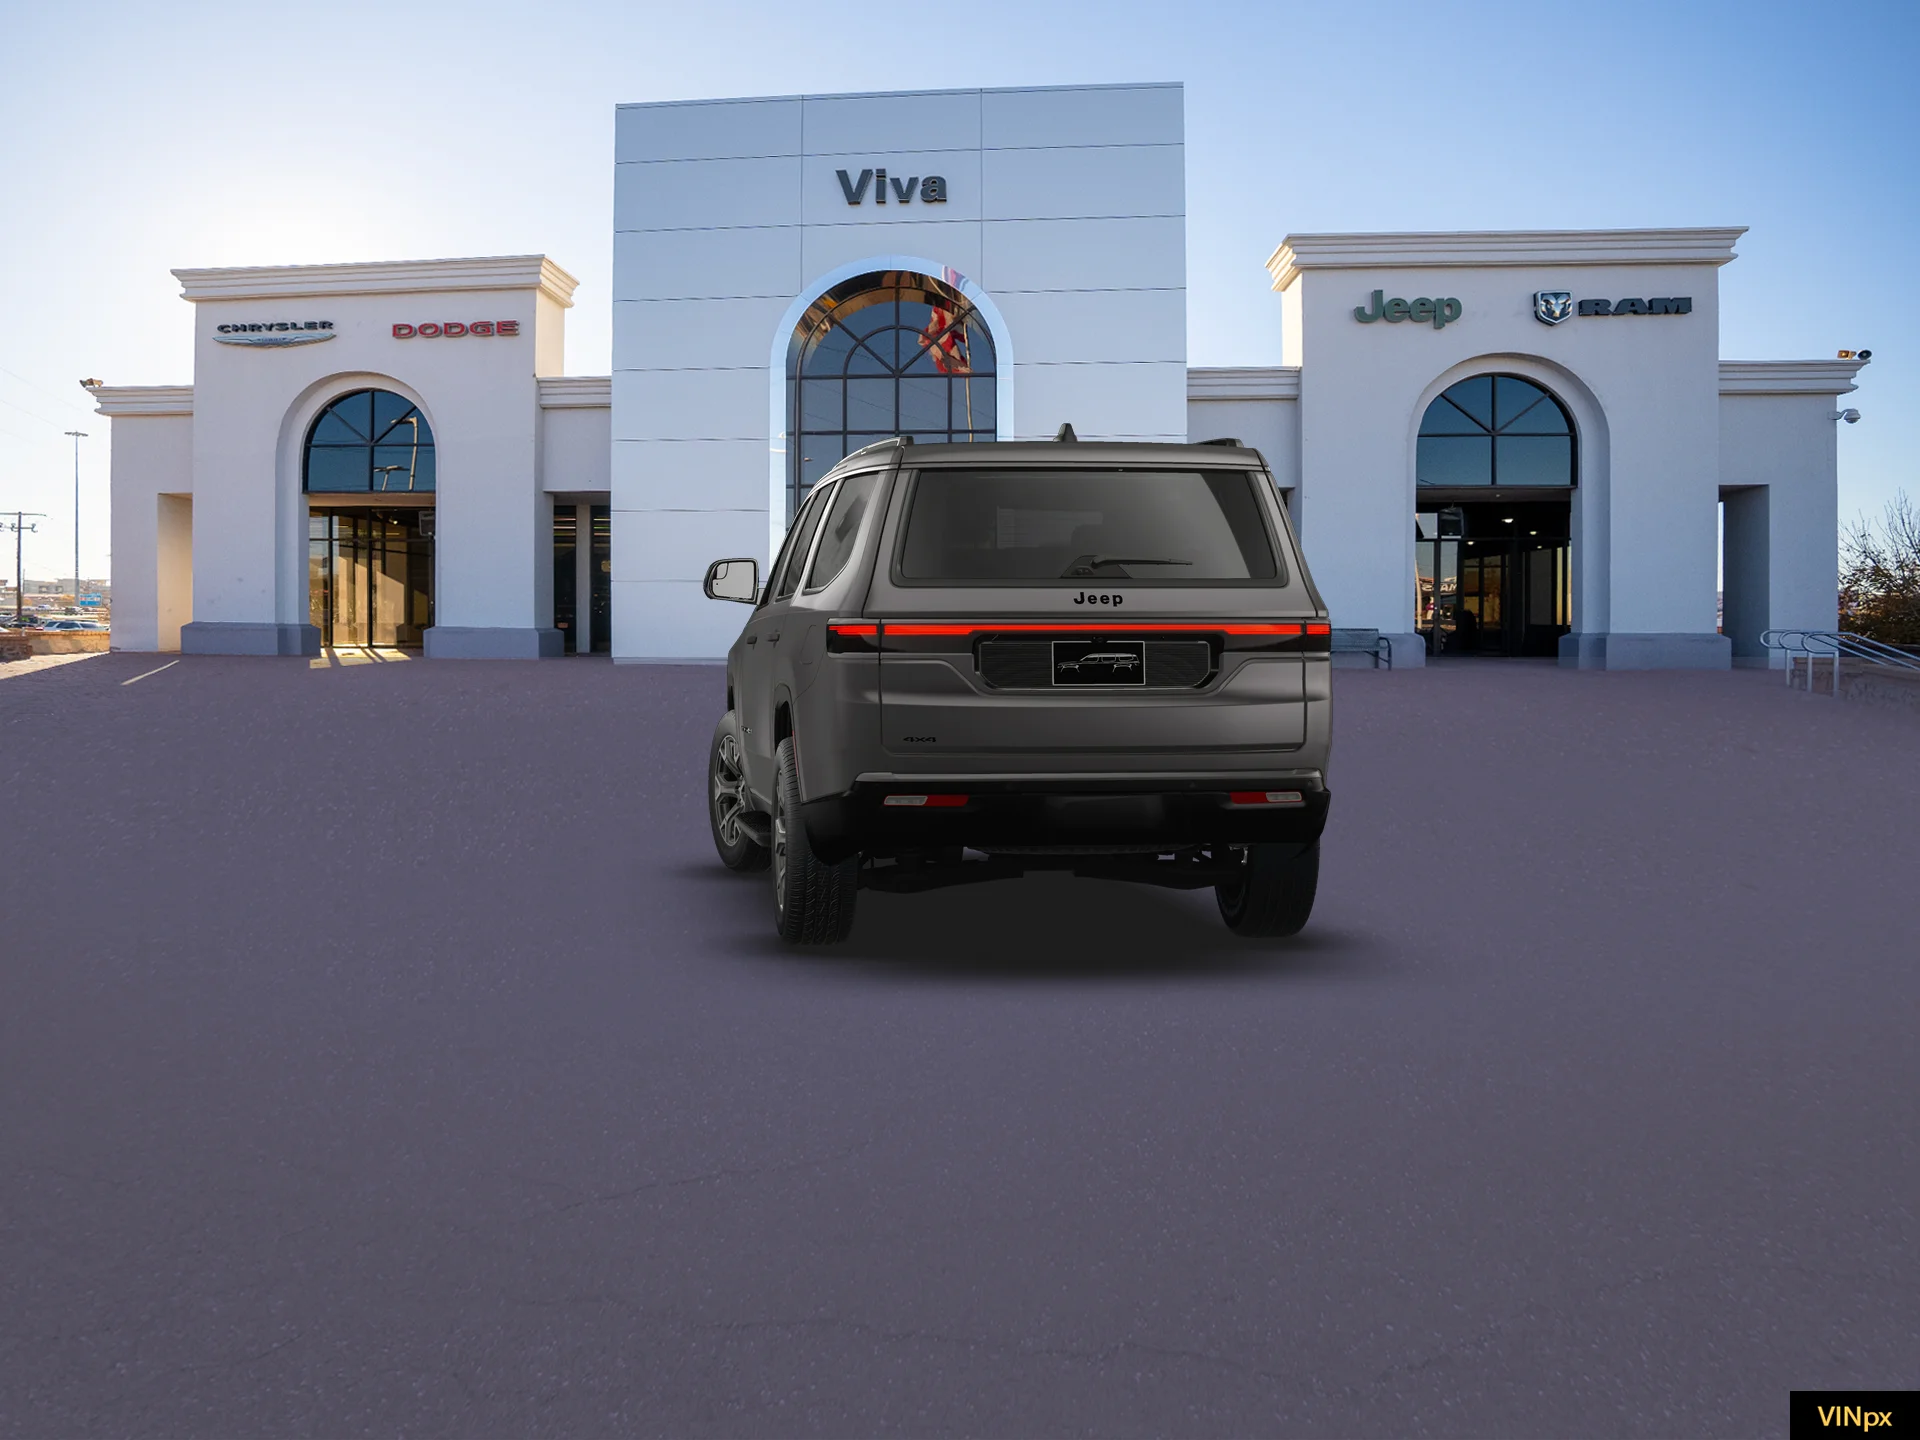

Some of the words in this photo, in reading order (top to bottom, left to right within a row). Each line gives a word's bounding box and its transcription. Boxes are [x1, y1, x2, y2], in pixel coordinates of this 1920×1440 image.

[835, 168, 948, 205] Viva
[1353, 289, 1463, 330] Jeep
[1578, 296, 1692, 316] RAM
[217, 320, 334, 334] CHRYSLER
[392, 319, 520, 339] DODGE
[1073, 591, 1124, 607] Jeep
